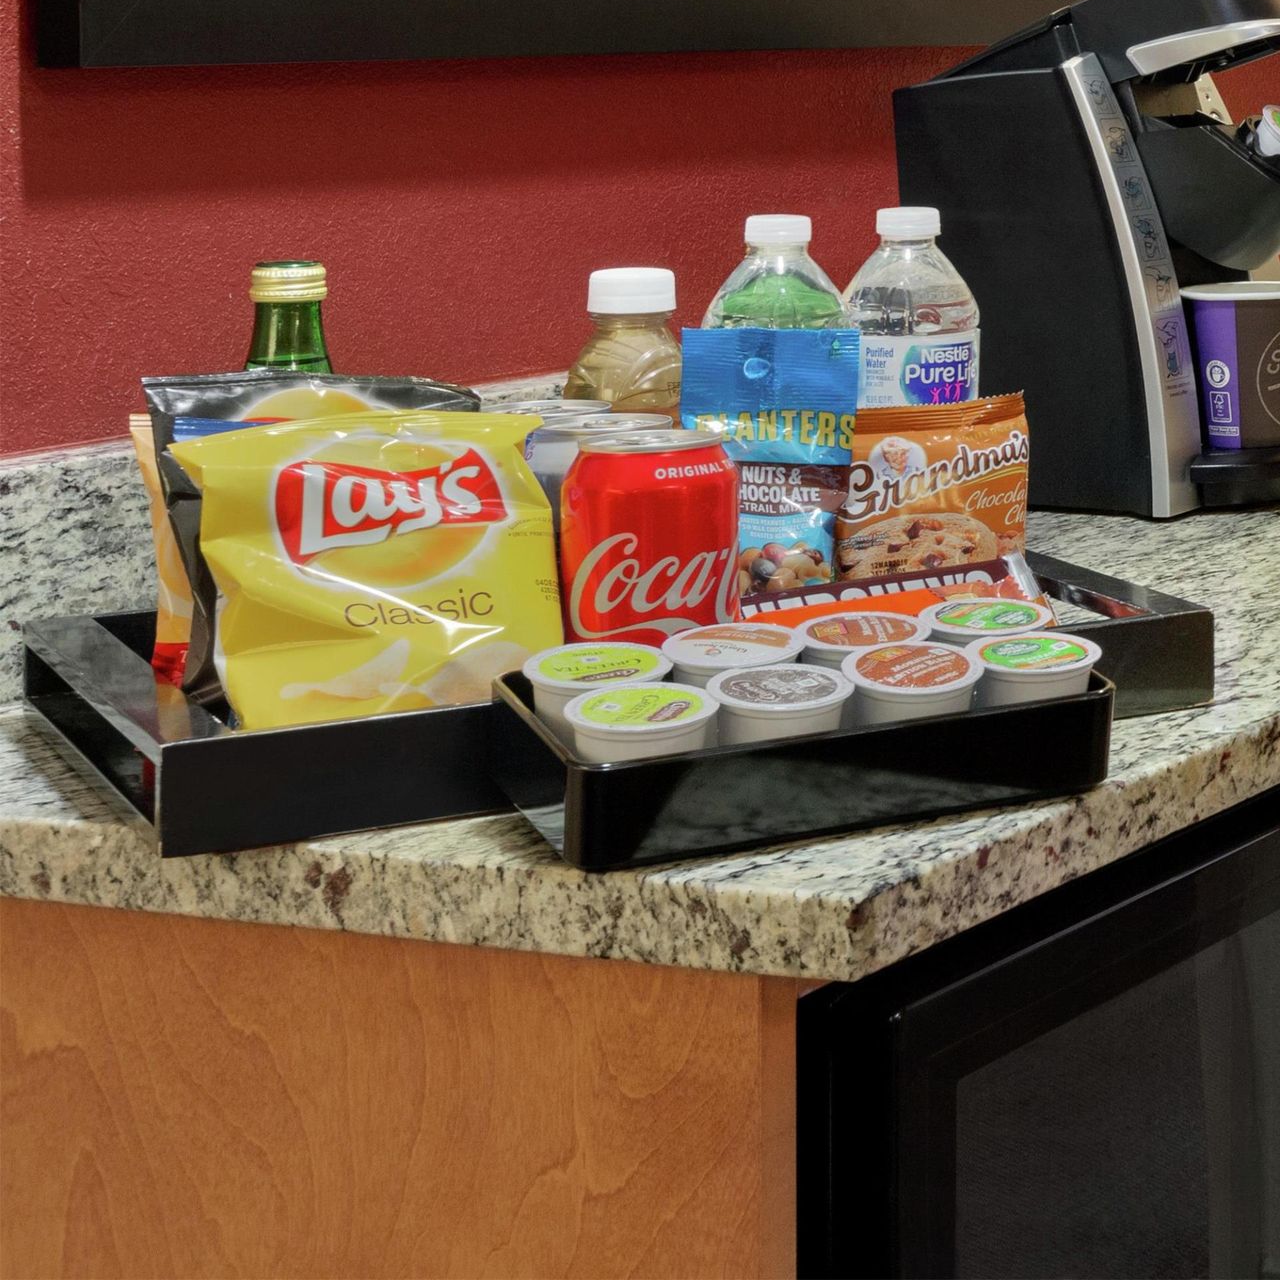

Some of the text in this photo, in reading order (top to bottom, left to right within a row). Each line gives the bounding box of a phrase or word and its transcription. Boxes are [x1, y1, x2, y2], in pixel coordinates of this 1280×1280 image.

[866, 347, 894, 358] Purified
[866, 358, 886, 368] Water
[905, 364, 955, 384] Pure
[655, 463, 723, 479] ORIGINAL
[742, 466, 801, 485] NUTS &
[838, 431, 1028, 519] Grandma's
[739, 486, 821, 504] HOCOLATE
[300, 461, 482, 555] Lay's
[344, 588, 494, 628] Classic
